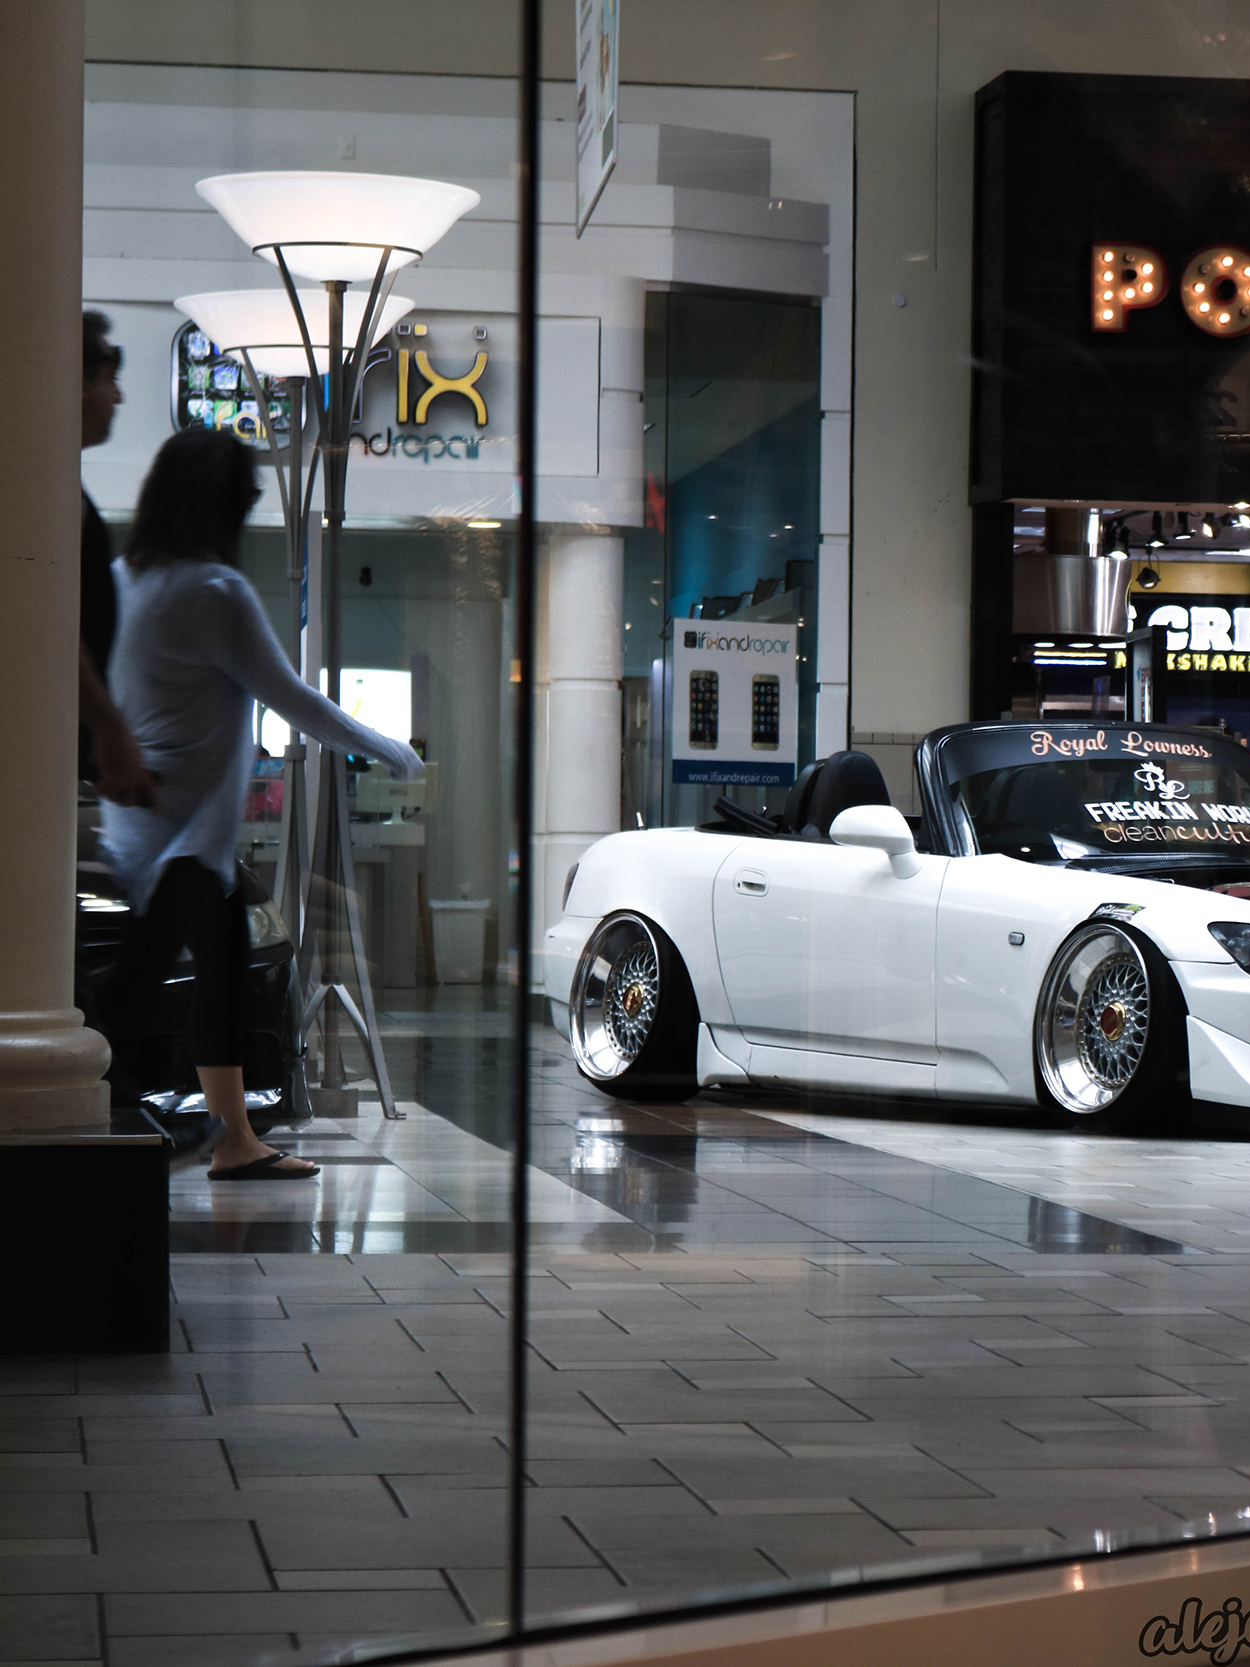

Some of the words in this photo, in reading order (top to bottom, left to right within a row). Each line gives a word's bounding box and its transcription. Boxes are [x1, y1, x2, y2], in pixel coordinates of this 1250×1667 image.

[350, 426, 486, 464] ndrepair
[698, 632, 790, 656] ifixandrepair
[1030, 730, 1108, 756] Royal
[1120, 731, 1212, 758] Lowness
[688, 772, 780, 785] www.ifixandrepair.com
[1084, 801, 1198, 823] FREAKIN
